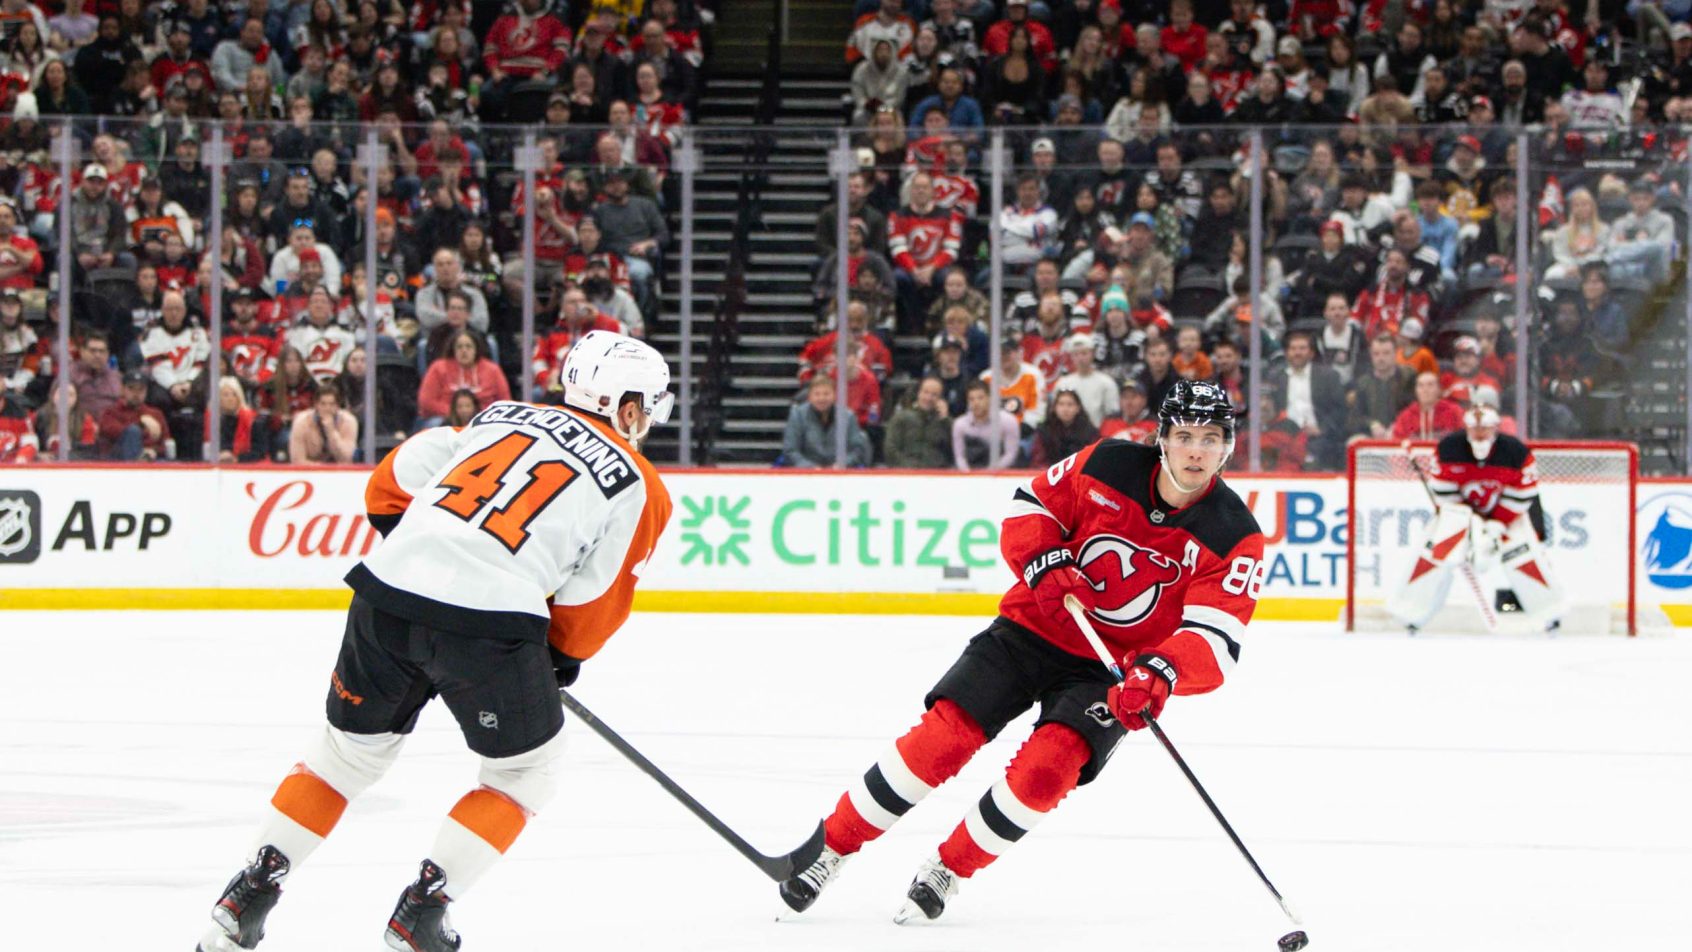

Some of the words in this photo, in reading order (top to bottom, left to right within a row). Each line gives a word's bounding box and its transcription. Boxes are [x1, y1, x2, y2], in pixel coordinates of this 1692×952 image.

[568, 367, 579, 385] 41
[1192, 385, 1213, 398] 86
[480, 405, 629, 489] GLENDENING
[432, 429, 582, 556] 41
[1181, 539, 1200, 576] A
